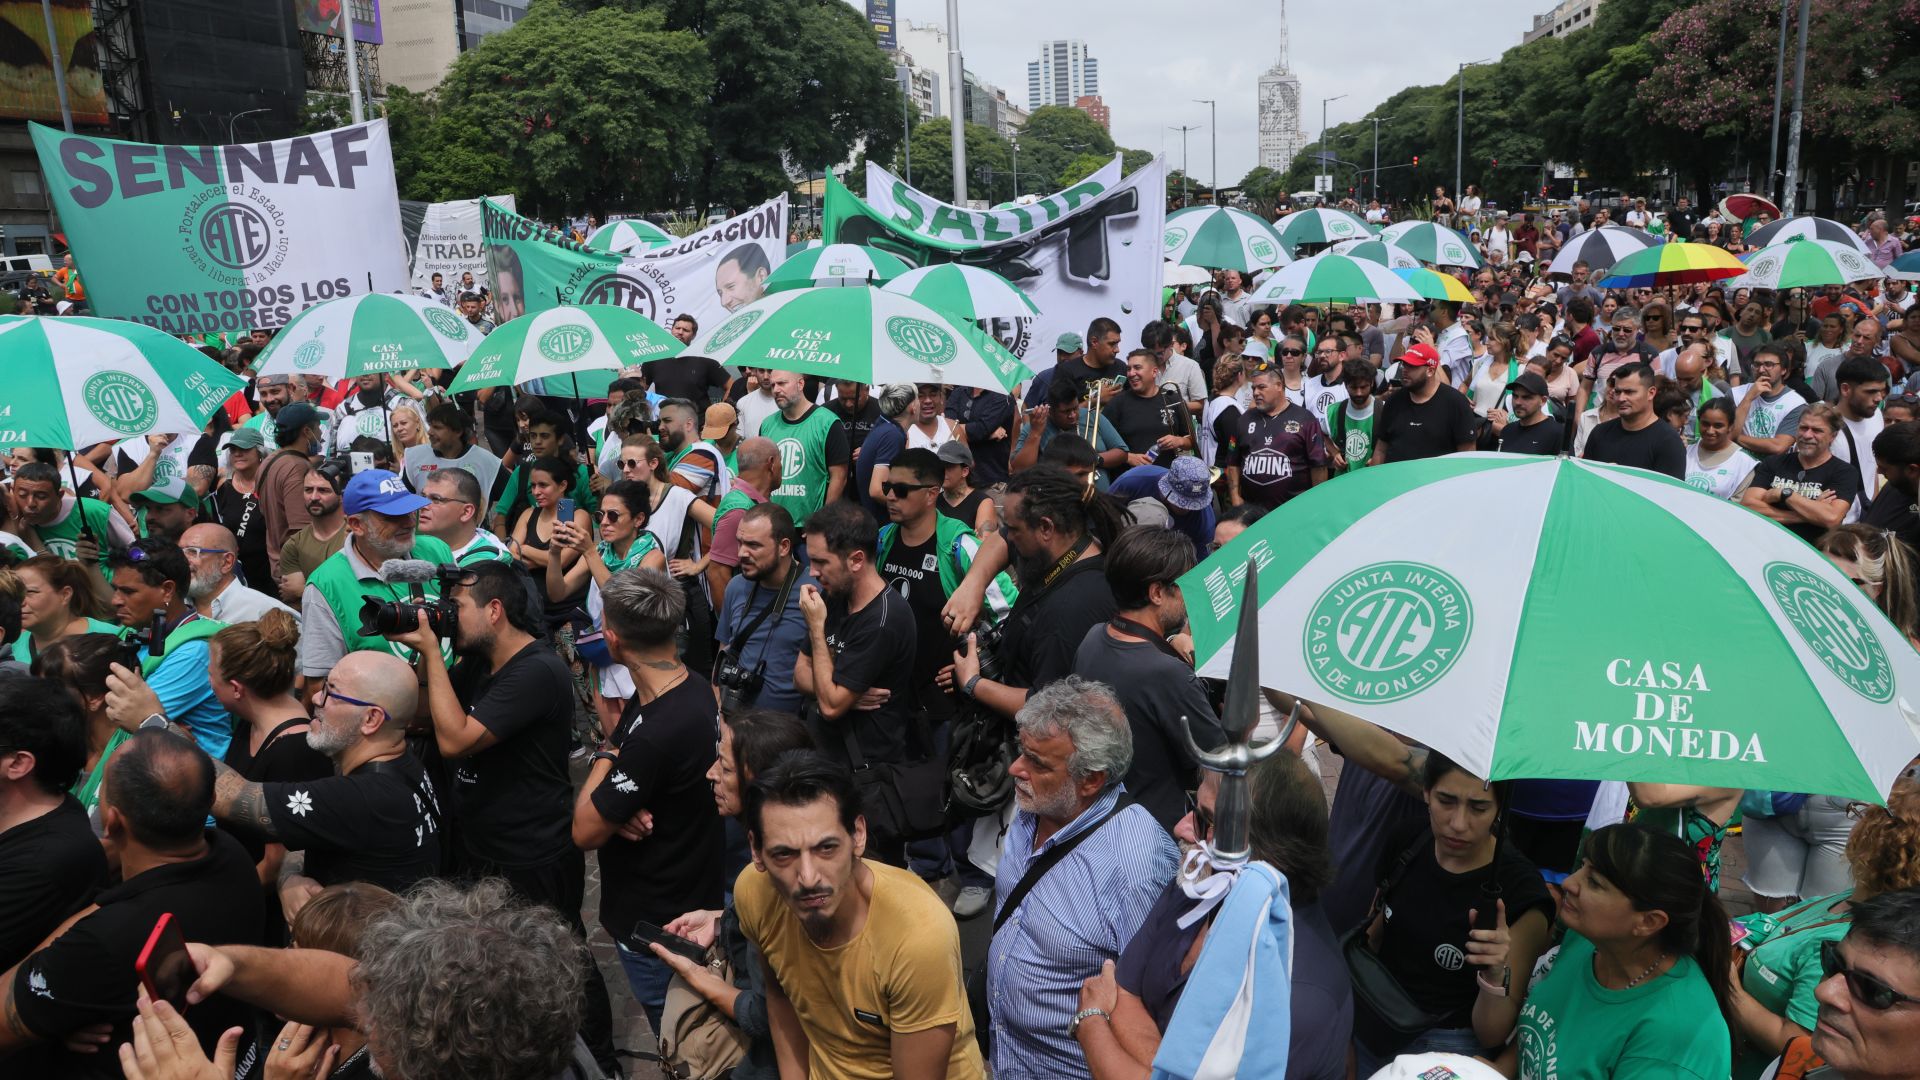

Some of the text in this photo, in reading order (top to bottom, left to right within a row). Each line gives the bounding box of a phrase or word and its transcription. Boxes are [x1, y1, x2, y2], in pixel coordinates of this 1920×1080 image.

[59, 127, 369, 209] SENNAF
[179, 184, 285, 236] Fortalecer el Estado
[205, 209, 264, 263] ATE
[420, 233, 468, 241] Ministerio de
[182, 237, 289, 286] para liberar la Nación
[425, 262, 451, 271] Empleo
[146, 294, 200, 315] CON
[204, 284, 295, 311] TODOS
[301, 278, 351, 302] LOS
[640, 263, 675, 305] Estado
[550, 331, 582, 353] ATE
[625, 331, 649, 343] CASA
[636, 339, 649, 348] DE
[790, 328, 832, 341] CASA
[797, 339, 820, 351] DE
[902, 326, 942, 353] ATE
[372, 344, 403, 353] CASA
[380, 352, 399, 361] DE
[480, 353, 502, 365] CASA
[630, 343, 670, 358] MONEDA
[764, 347, 842, 365] MONEDA
[363, 359, 419, 371] MONEDA
[465, 369, 502, 384] MONEDA
[481, 362, 494, 372] DE
[87, 374, 146, 400] JUNTA INTERNA
[184, 371, 206, 390] CASA
[196, 382, 213, 398] DE
[104, 387, 143, 420] ATE
[196, 384, 230, 417] MONEDA
[91, 399, 157, 432] CASA DE MONEDA
[1248, 421, 1256, 434] 8
[1243, 455, 1293, 478] ANDINA
[1248, 539, 1277, 574] CASA
[898, 567, 924, 580] 30.000
[1229, 560, 1248, 587] DE
[1203, 566, 1236, 623] MONEDA
[1333, 571, 1461, 631] JUNTA INTERNA
[1775, 570, 1843, 628] JUNTA INTERNA
[1340, 591, 1432, 670] ATE
[1798, 589, 1868, 669] ATE
[1312, 615, 1452, 696] CASA DE MONEDA
[1812, 617, 1890, 696] CASA DE MONEDA
[1606, 658, 1711, 691] CASA
[1632, 691, 1694, 724] DE
[1573, 720, 1768, 763] MONEDA
[1437, 946, 1463, 969] ATE
[1536, 1010, 1555, 1031] DE
